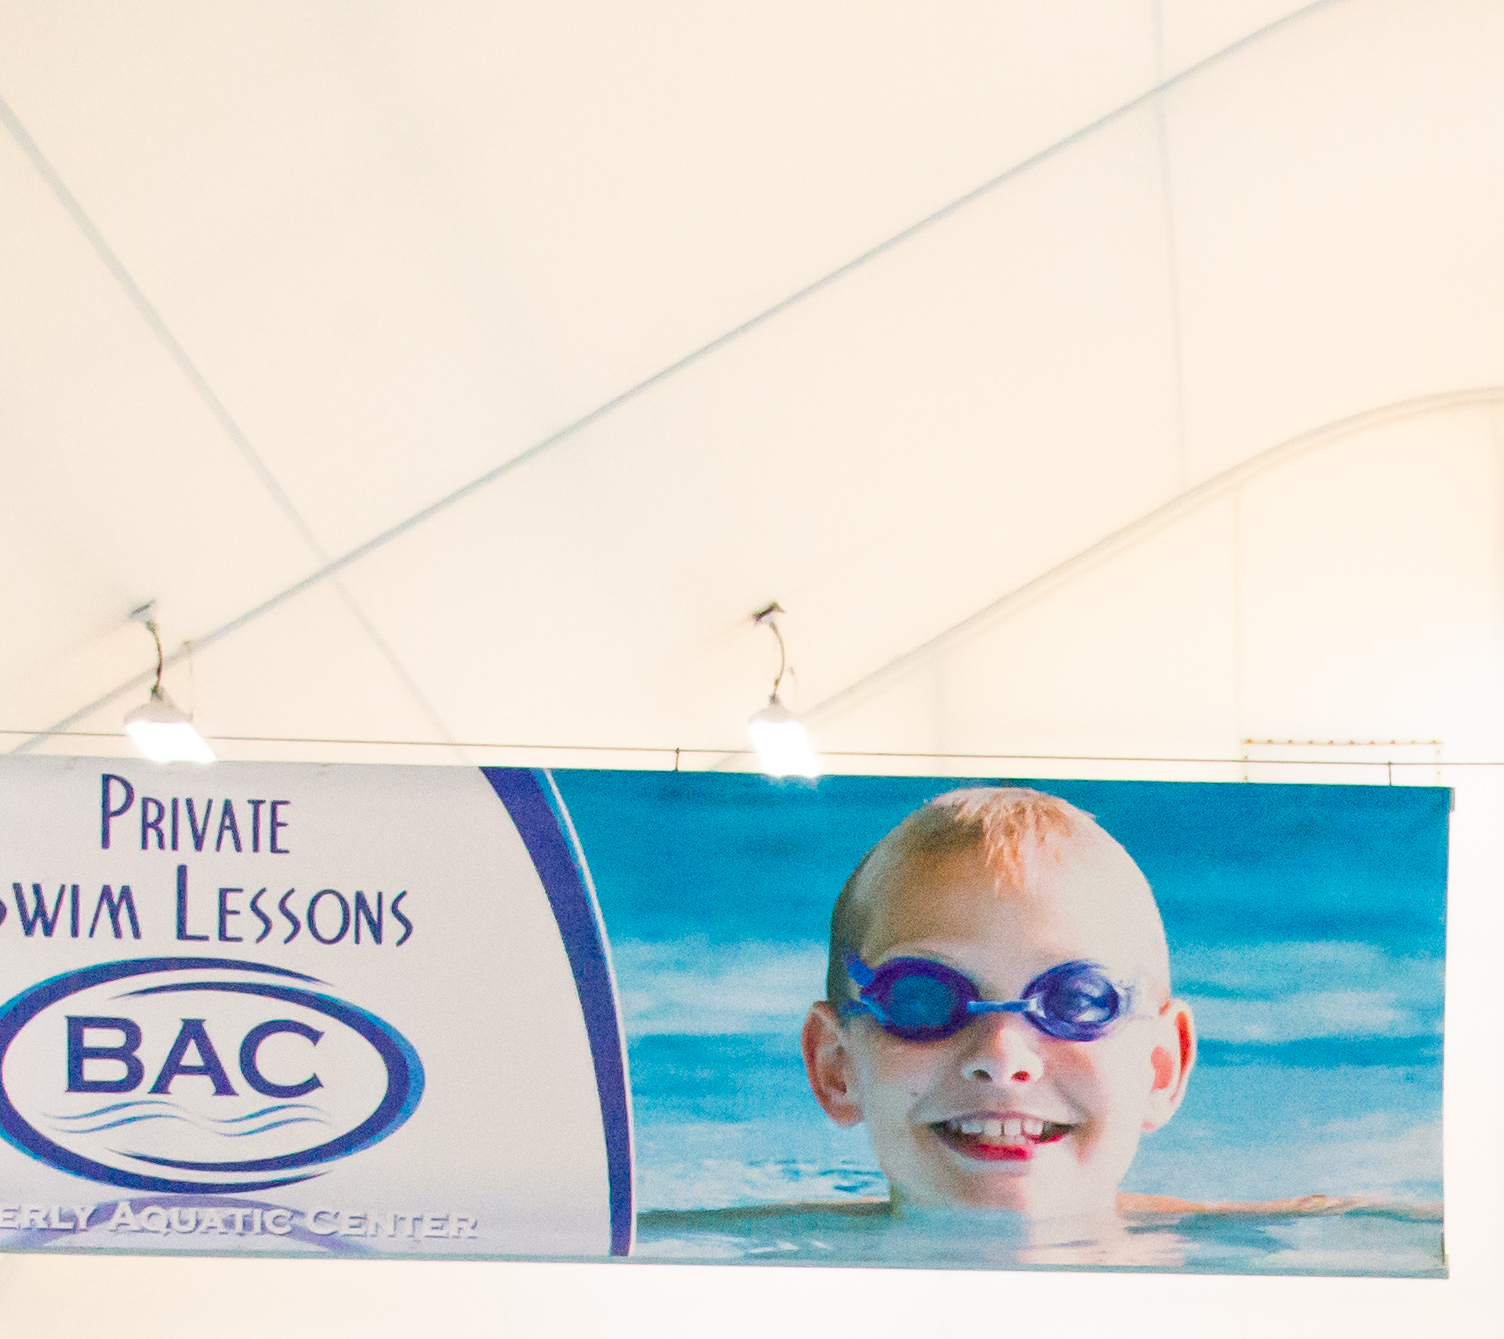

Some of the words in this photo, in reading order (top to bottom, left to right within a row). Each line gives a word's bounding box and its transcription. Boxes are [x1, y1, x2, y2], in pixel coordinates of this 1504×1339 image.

[101, 773, 291, 854] PRIVATE
[176, 864, 414, 947] LESSONS
[64, 1015, 325, 1099] BAC
[107, 1201, 295, 1237] AQUATIC
[307, 1208, 480, 1240] CENTER
